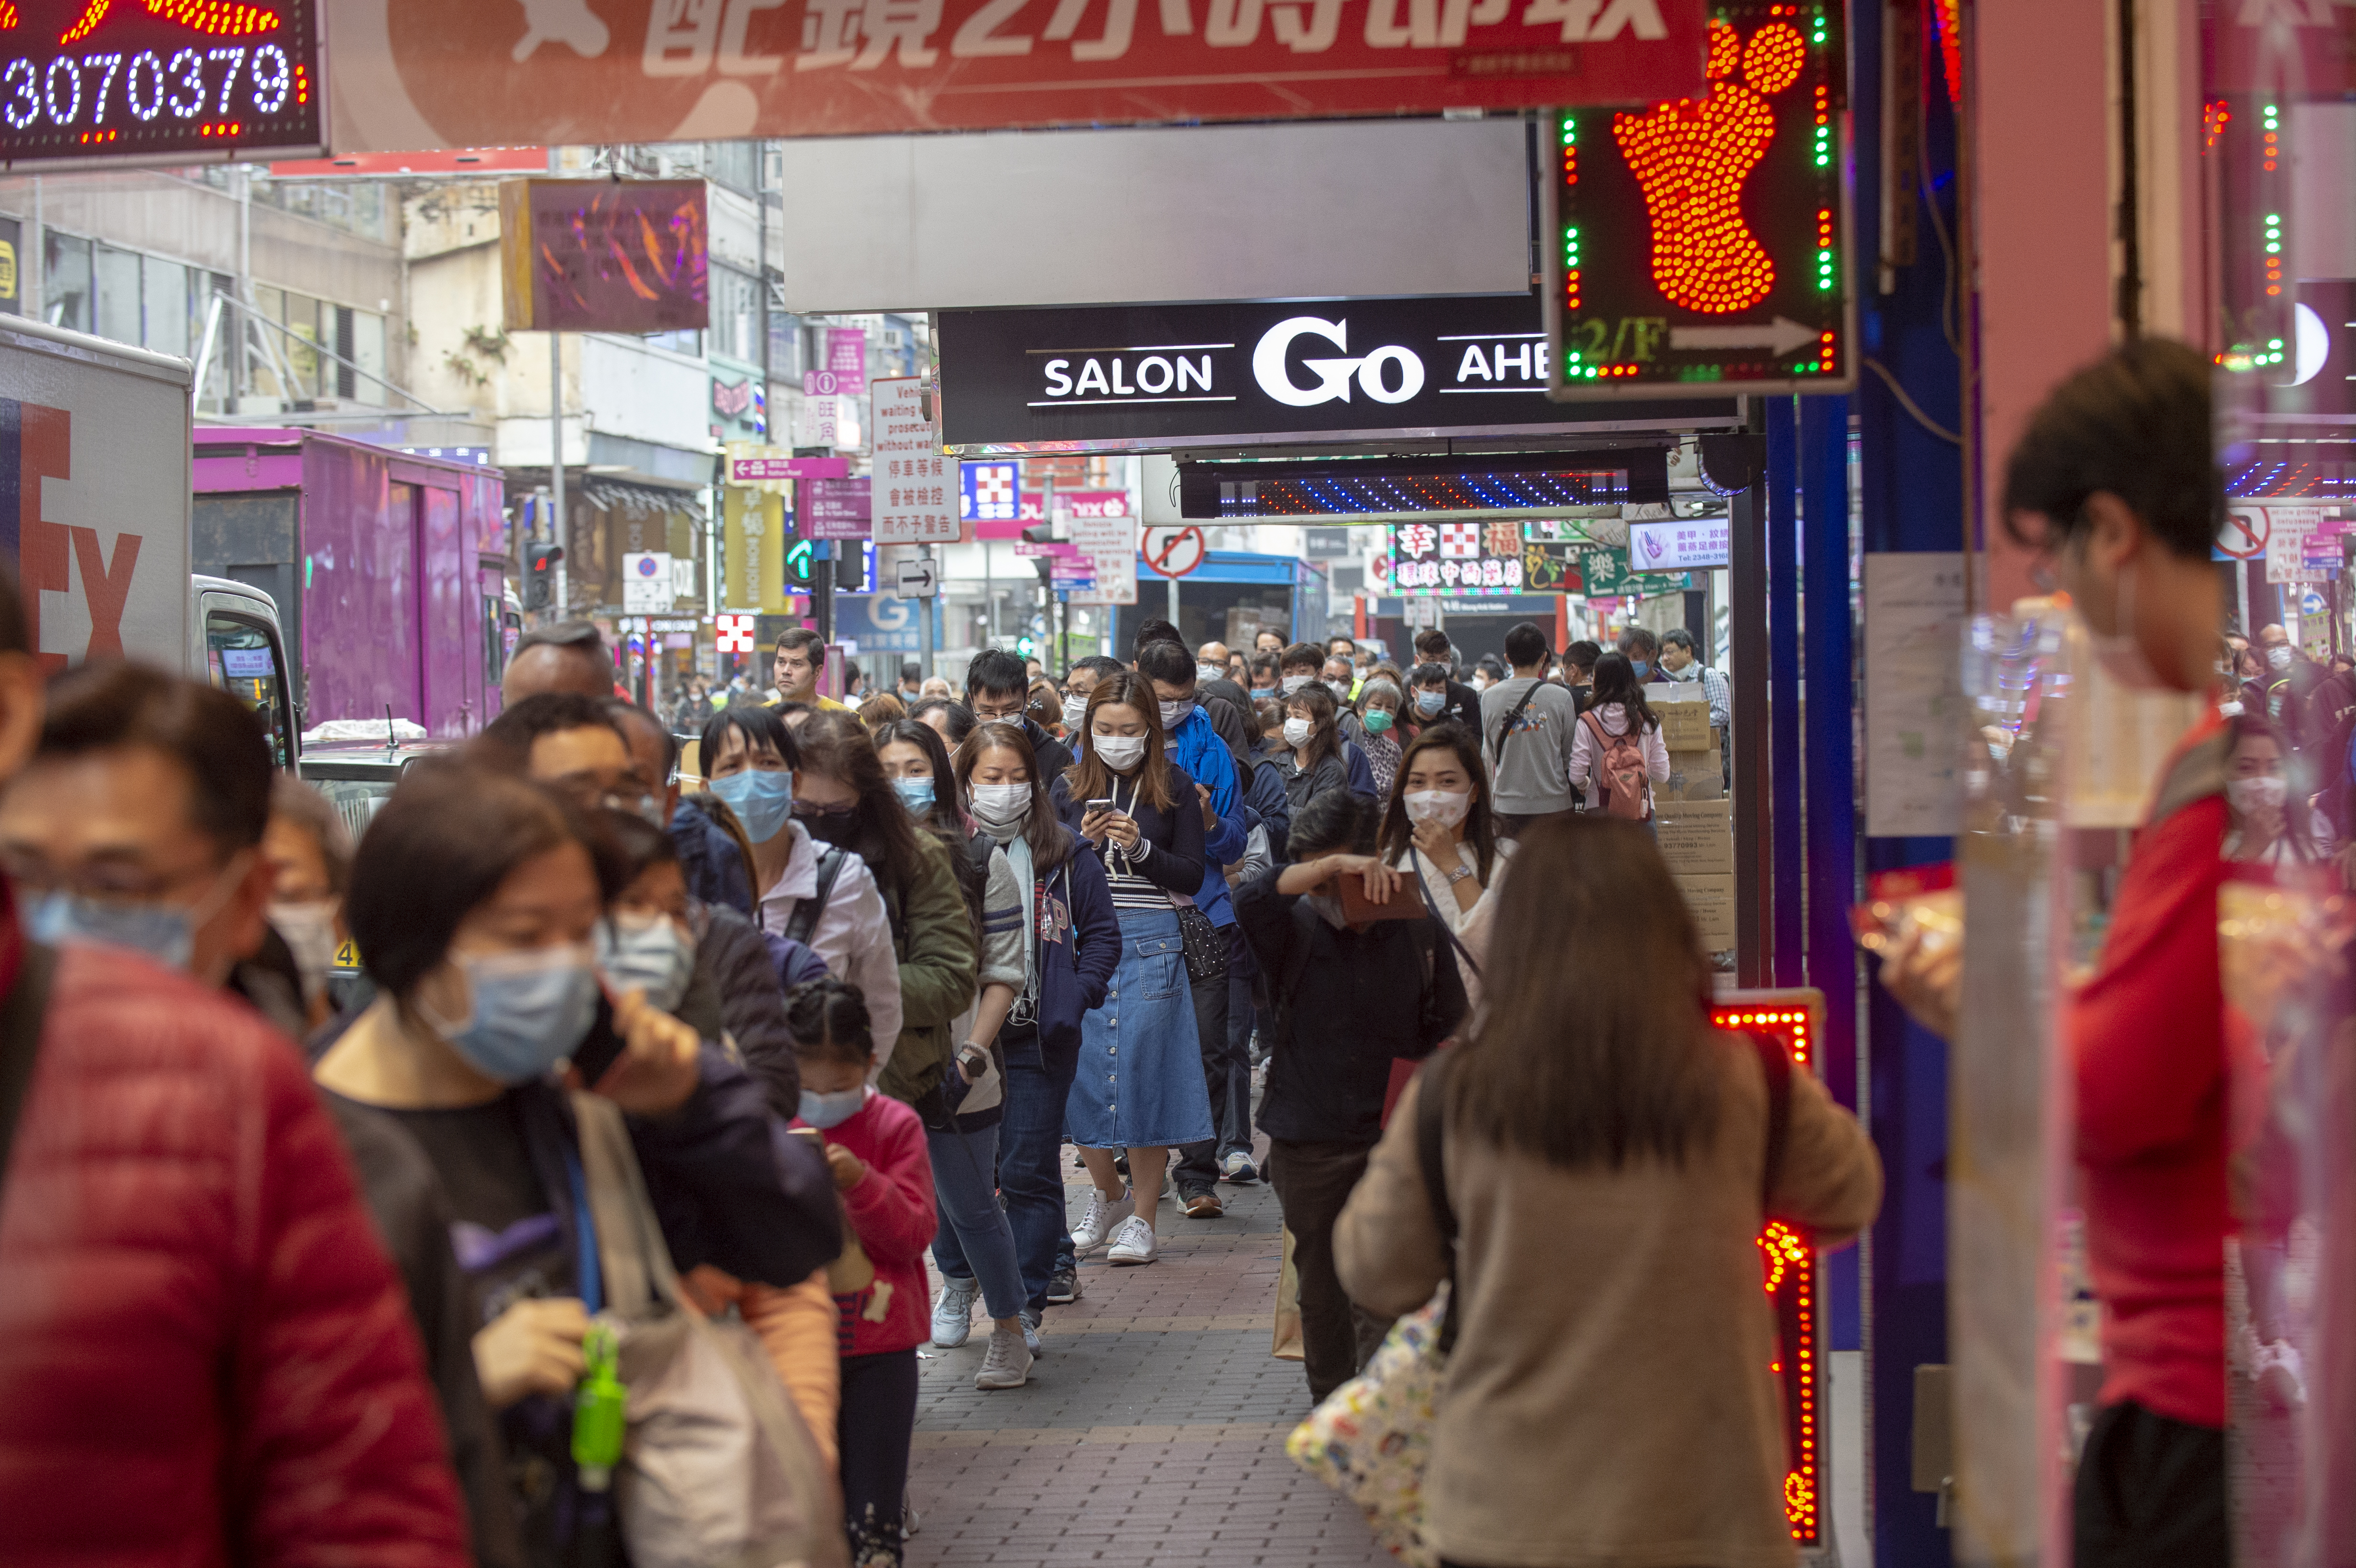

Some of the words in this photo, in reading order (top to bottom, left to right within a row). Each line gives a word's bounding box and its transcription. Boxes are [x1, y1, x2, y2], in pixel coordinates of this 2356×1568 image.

[4, 44, 289, 129] 3070379
[1579, 317, 1667, 362] 2/F
[1045, 355, 1212, 397] SALON
[1253, 316, 1425, 406] Go
[1457, 342, 1550, 382] AHE
[881, 406, 916, 417] waiting
[888, 424, 932, 436] prosecut
[876, 439, 913, 452] without
[889, 458, 943, 479] 停車等候
[889, 486, 944, 507] 會被檢控
[883, 515, 950, 534] 而不予警告
